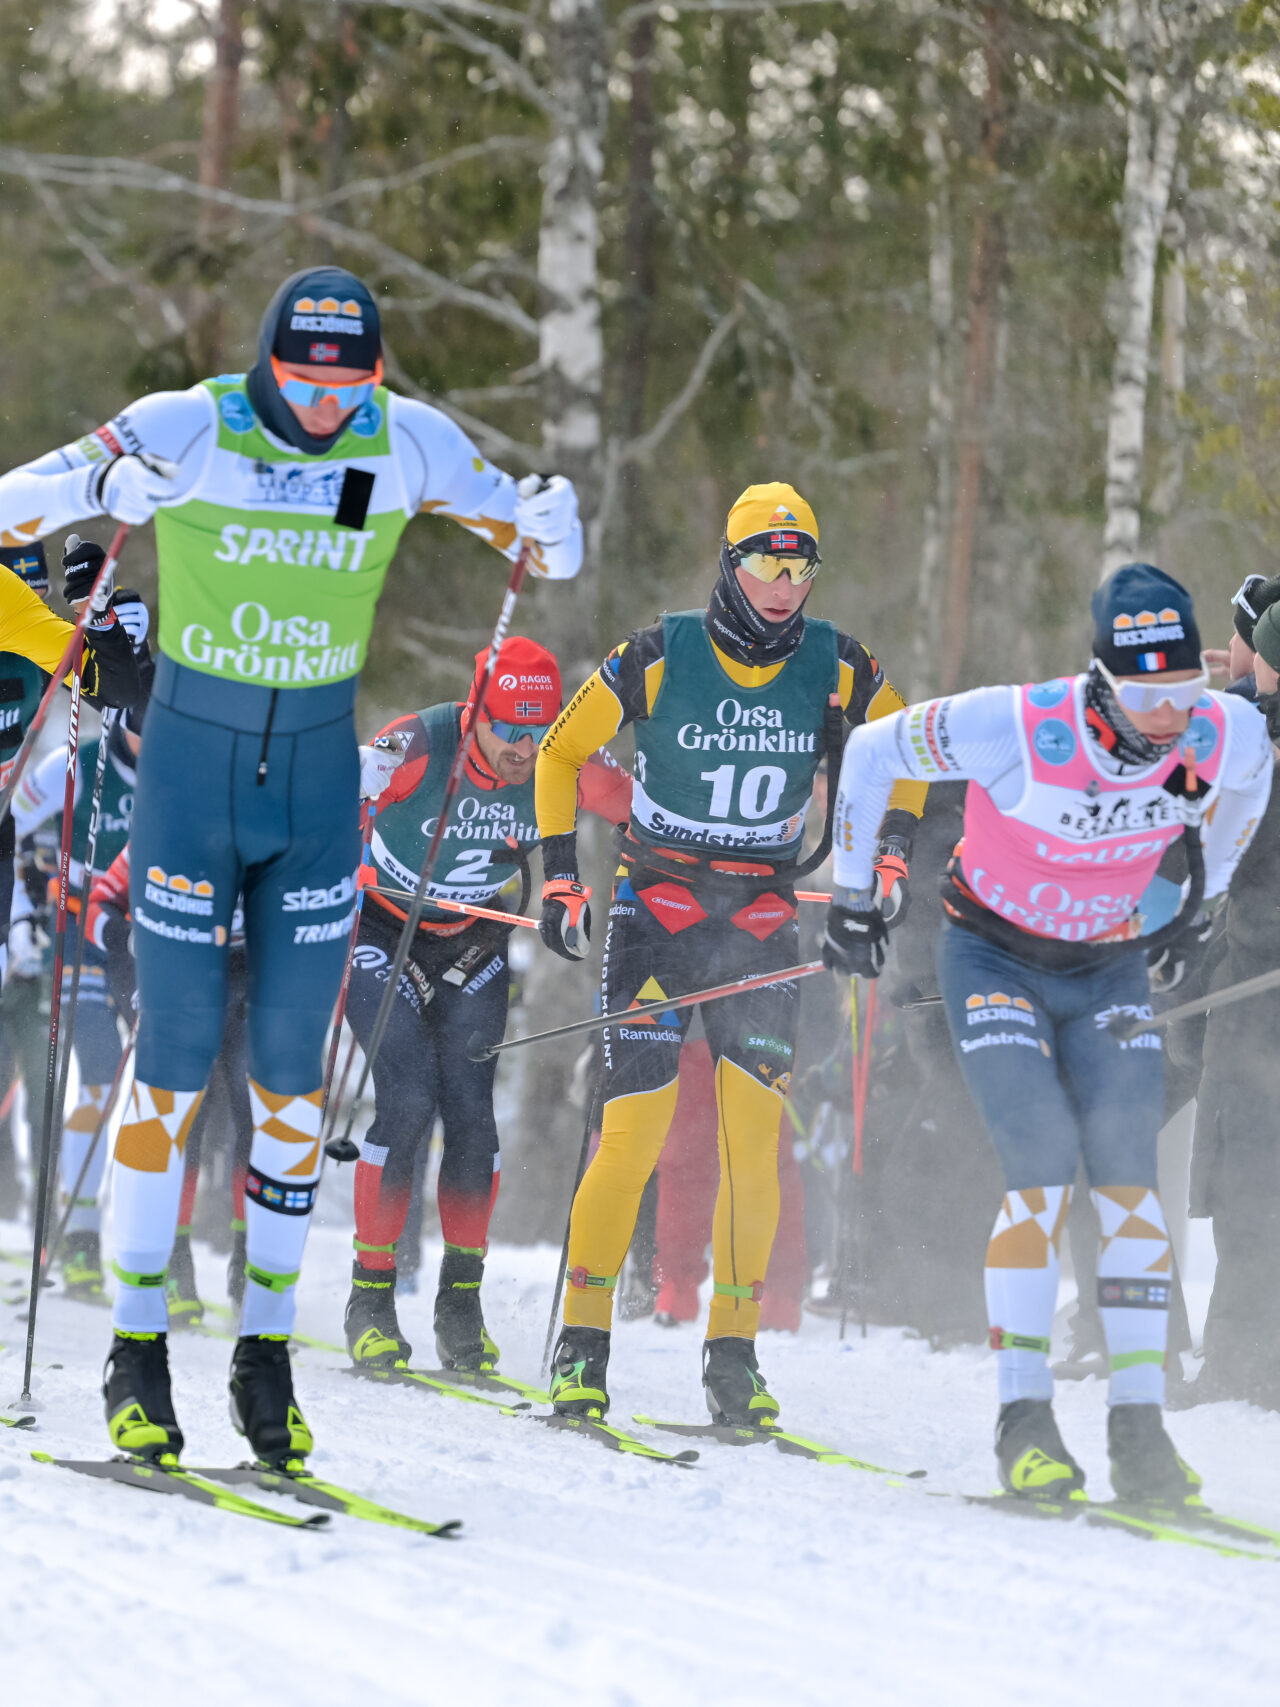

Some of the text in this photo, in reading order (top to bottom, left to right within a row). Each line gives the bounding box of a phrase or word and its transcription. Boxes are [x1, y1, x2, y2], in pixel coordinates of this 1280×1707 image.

[214, 524, 376, 572] SPRINT
[231, 601, 332, 647] Orsa
[181, 623, 361, 683] Grönklitt
[519, 674, 552, 684] RAGDE
[716, 698, 783, 728] Orsa
[677, 723, 817, 753] Grönklitt
[457, 797, 515, 821] Orsa
[700, 764, 787, 820] 10
[444, 848, 494, 882] 2
[462, 954, 506, 996] TRIMTEX
[601, 920, 614, 1071] SWEDEMUNT
[619, 1028, 682, 1043] Ramudden
